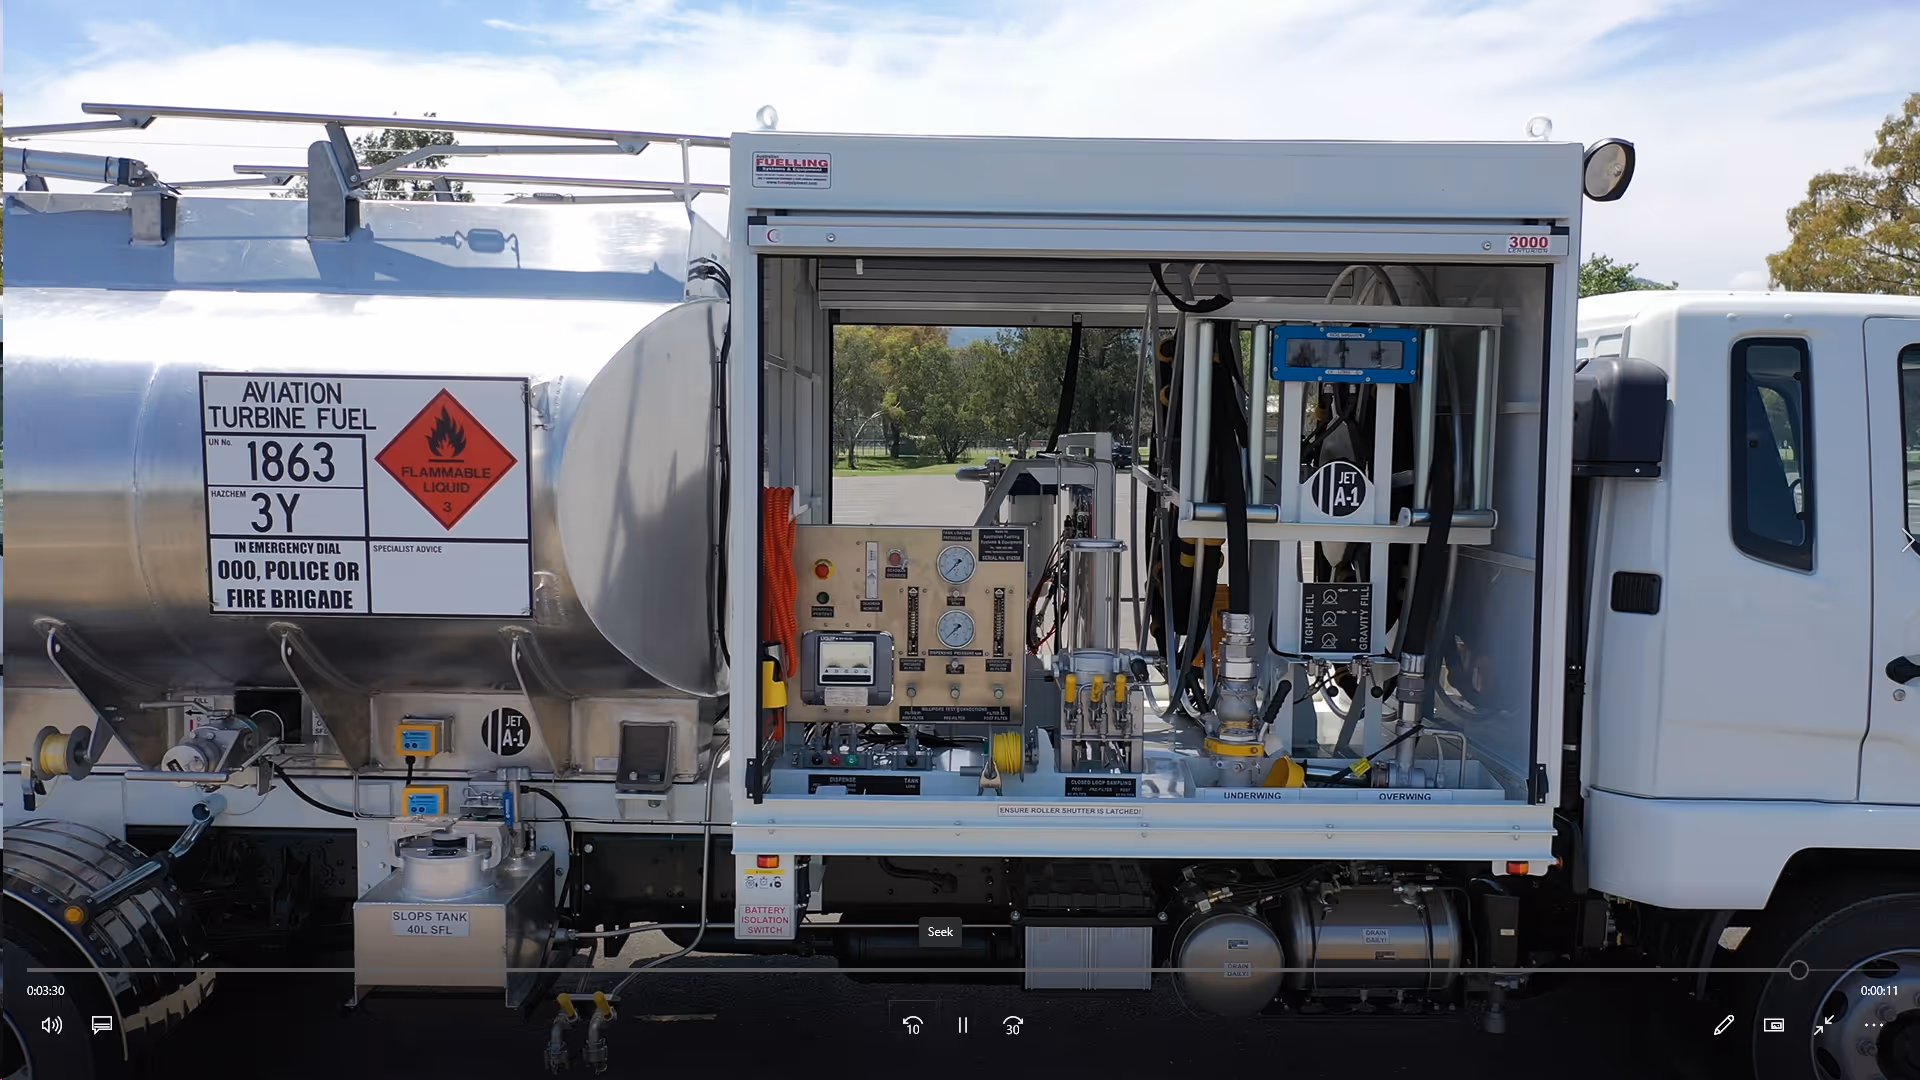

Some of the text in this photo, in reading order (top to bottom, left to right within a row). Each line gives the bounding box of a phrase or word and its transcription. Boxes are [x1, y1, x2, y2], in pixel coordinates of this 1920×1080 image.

[756, 158, 828, 167] FUELLING
[1509, 236, 1548, 248] 3000
[242, 381, 342, 404] AVIATION
[208, 406, 377, 430] TURBINE FUEL
[248, 440, 336, 482] 1863
[402, 466, 491, 479] FLAMMABLE
[1338, 472, 1358, 484] JET
[424, 482, 470, 493] LIQUID
[1334, 487, 1360, 506] A-1
[250, 492, 300, 532] 3Y
[442, 502, 452, 512] 3
[234, 542, 341, 554] IN EMERGENCY DIAL
[416, 546, 442, 554] ADVICE
[265, 560, 330, 581] POLICE
[334, 562, 360, 582] OR
[226, 588, 353, 610] FIRE BRIGADE
[1304, 594, 1314, 644] TIGHT FILL
[1359, 586, 1369, 650] GRAVITY FILL
[506, 715, 522, 726] JET
[502, 729, 525, 747] A-1
[1224, 792, 1281, 800] UNDERWING
[1379, 792, 1432, 801] OVERWING
[393, 912, 467, 922] SLOPS TANK
[407, 925, 452, 934] 40L SFL
